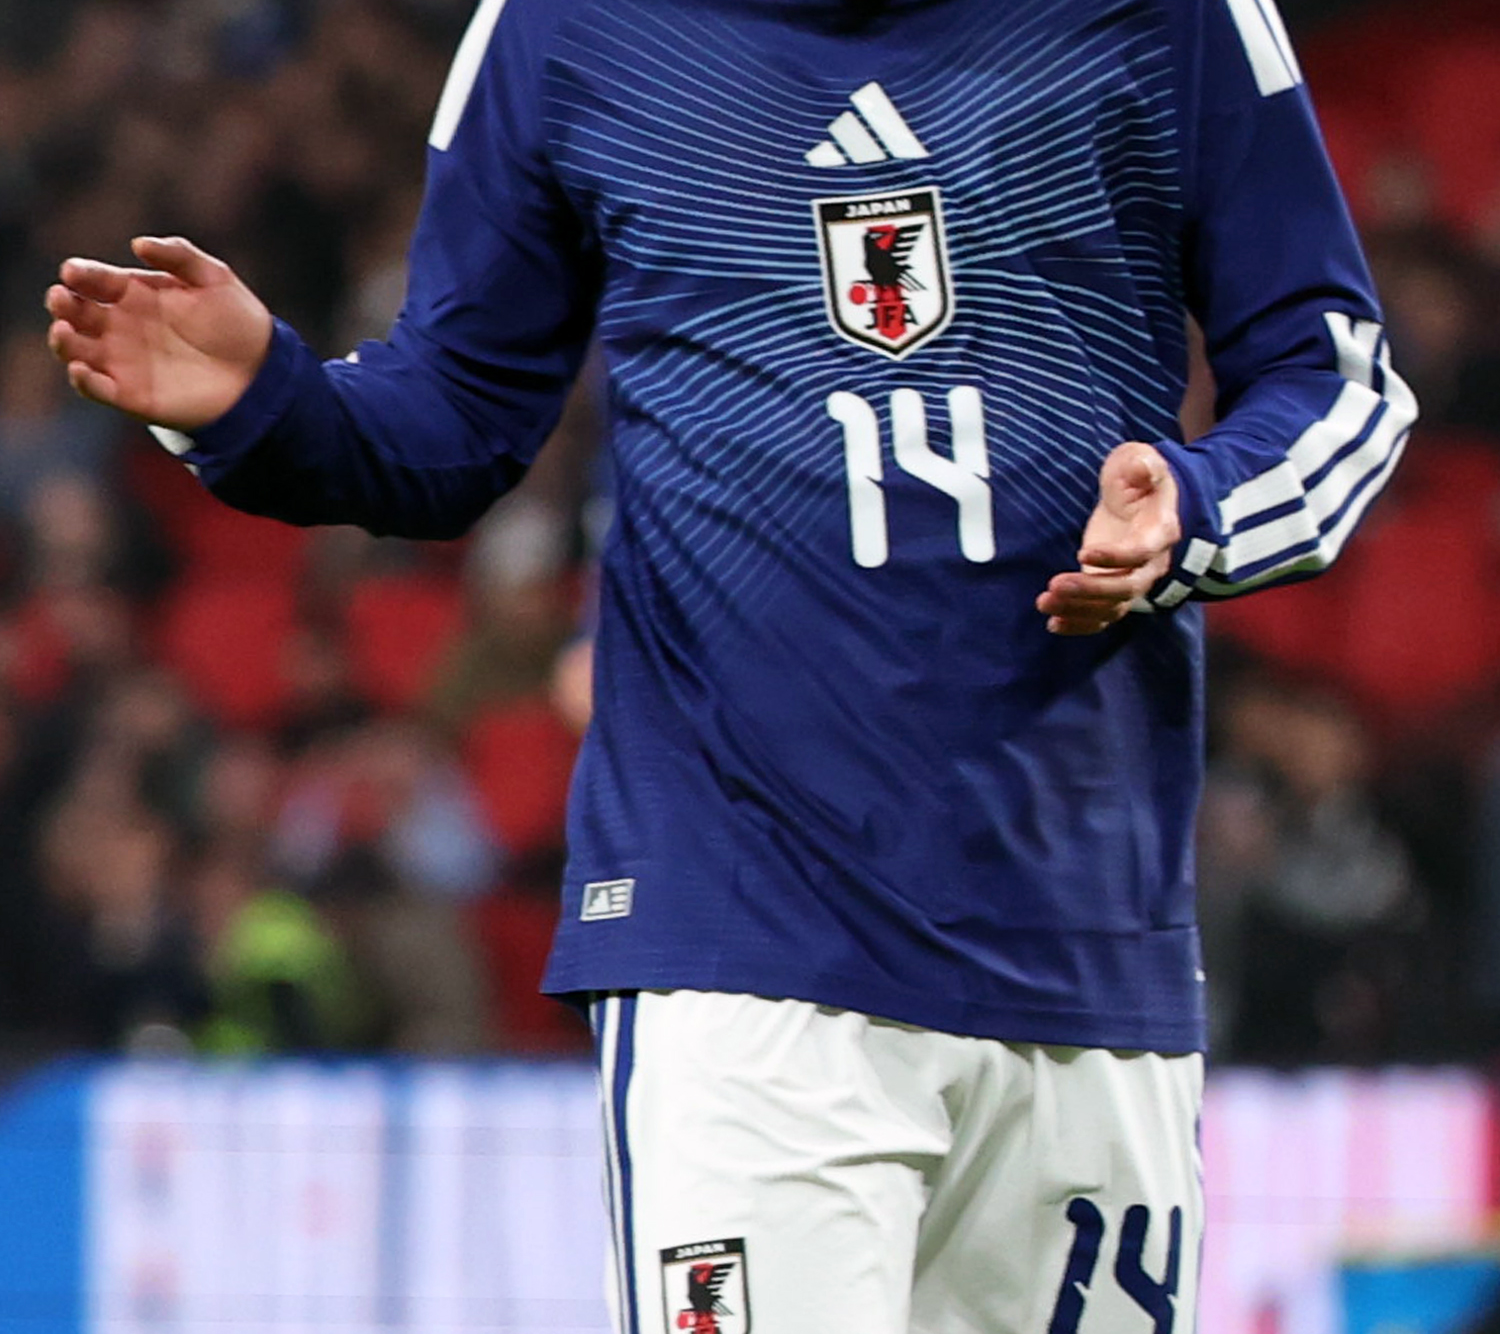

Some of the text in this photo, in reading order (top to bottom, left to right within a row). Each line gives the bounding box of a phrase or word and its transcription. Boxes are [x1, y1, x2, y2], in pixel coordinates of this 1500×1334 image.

[845, 198, 912, 218] JAPAN
[865, 304, 920, 329] JFA
[826, 385, 996, 568] 14
[675, 1242, 726, 1259] JAPAN
